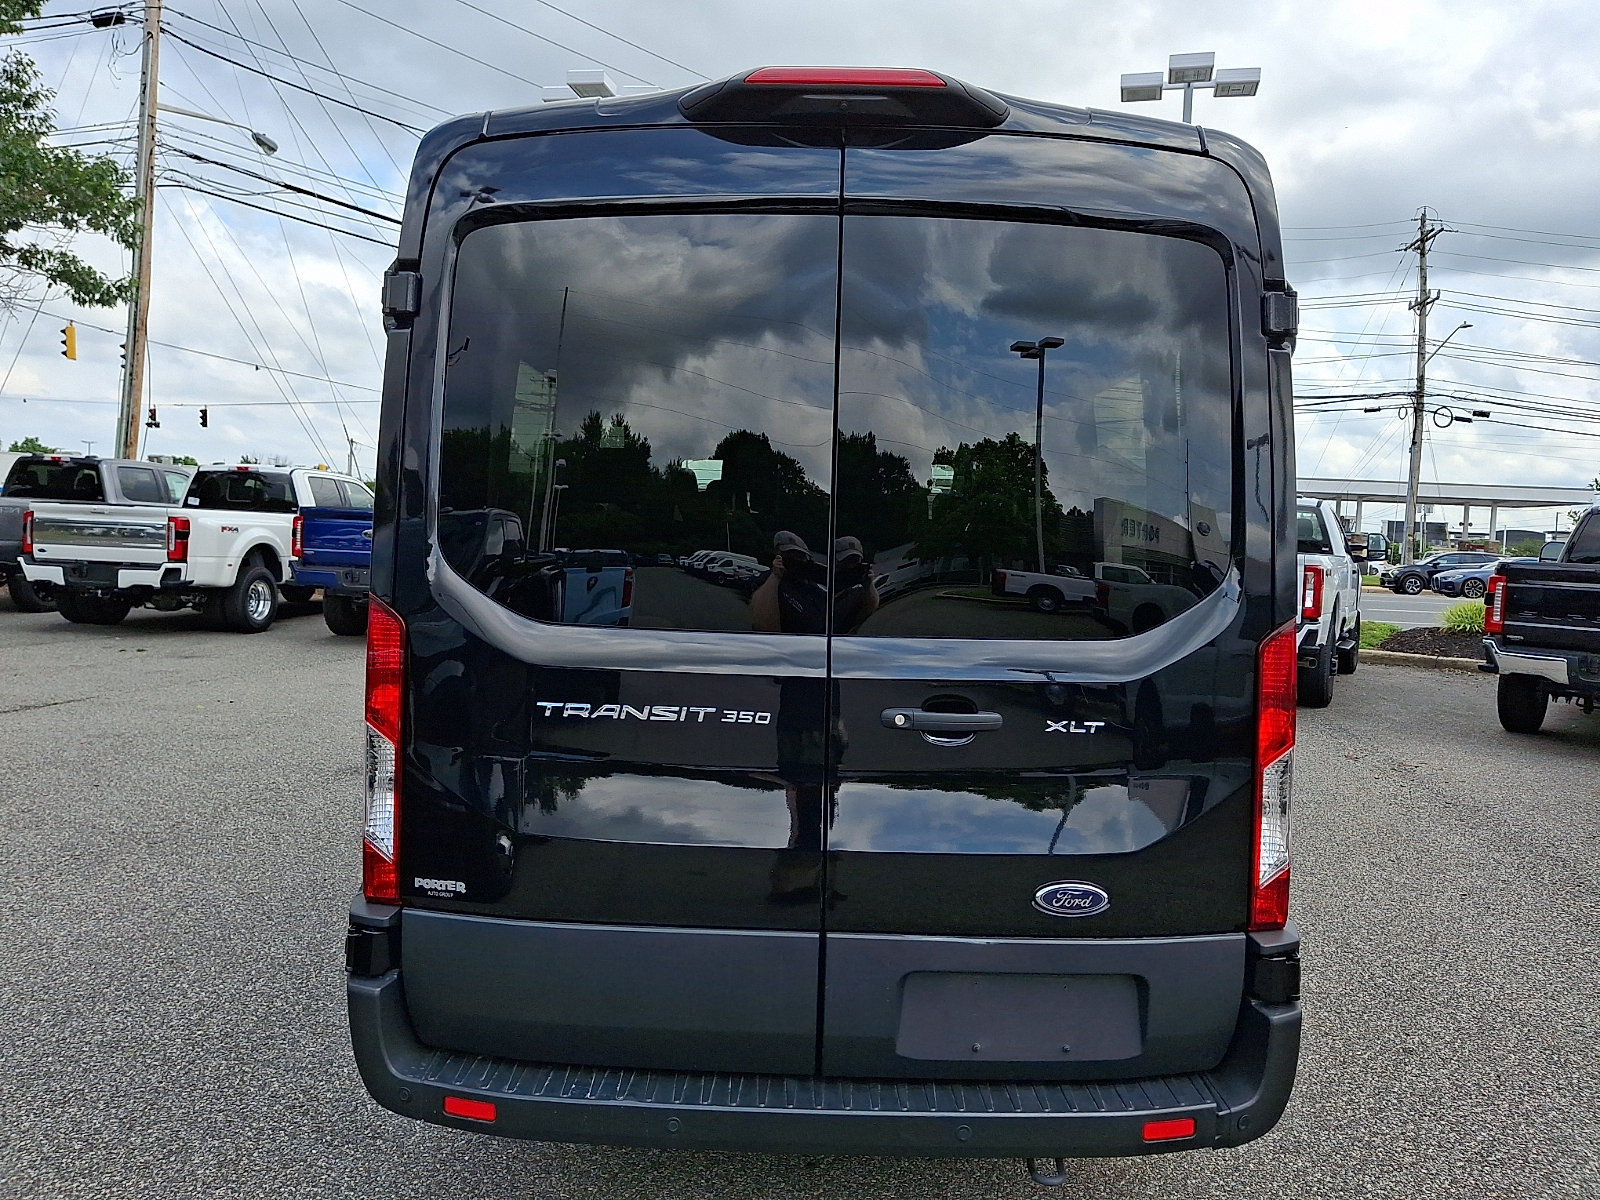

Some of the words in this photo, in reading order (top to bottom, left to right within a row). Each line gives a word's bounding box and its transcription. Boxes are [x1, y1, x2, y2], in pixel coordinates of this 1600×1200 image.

[536, 701, 717, 722] TRANSIT
[720, 710, 771, 724] 350
[1044, 720, 1105, 734] XLT
[414, 877, 467, 893] PORTER
[1052, 890, 1093, 907] Ford
